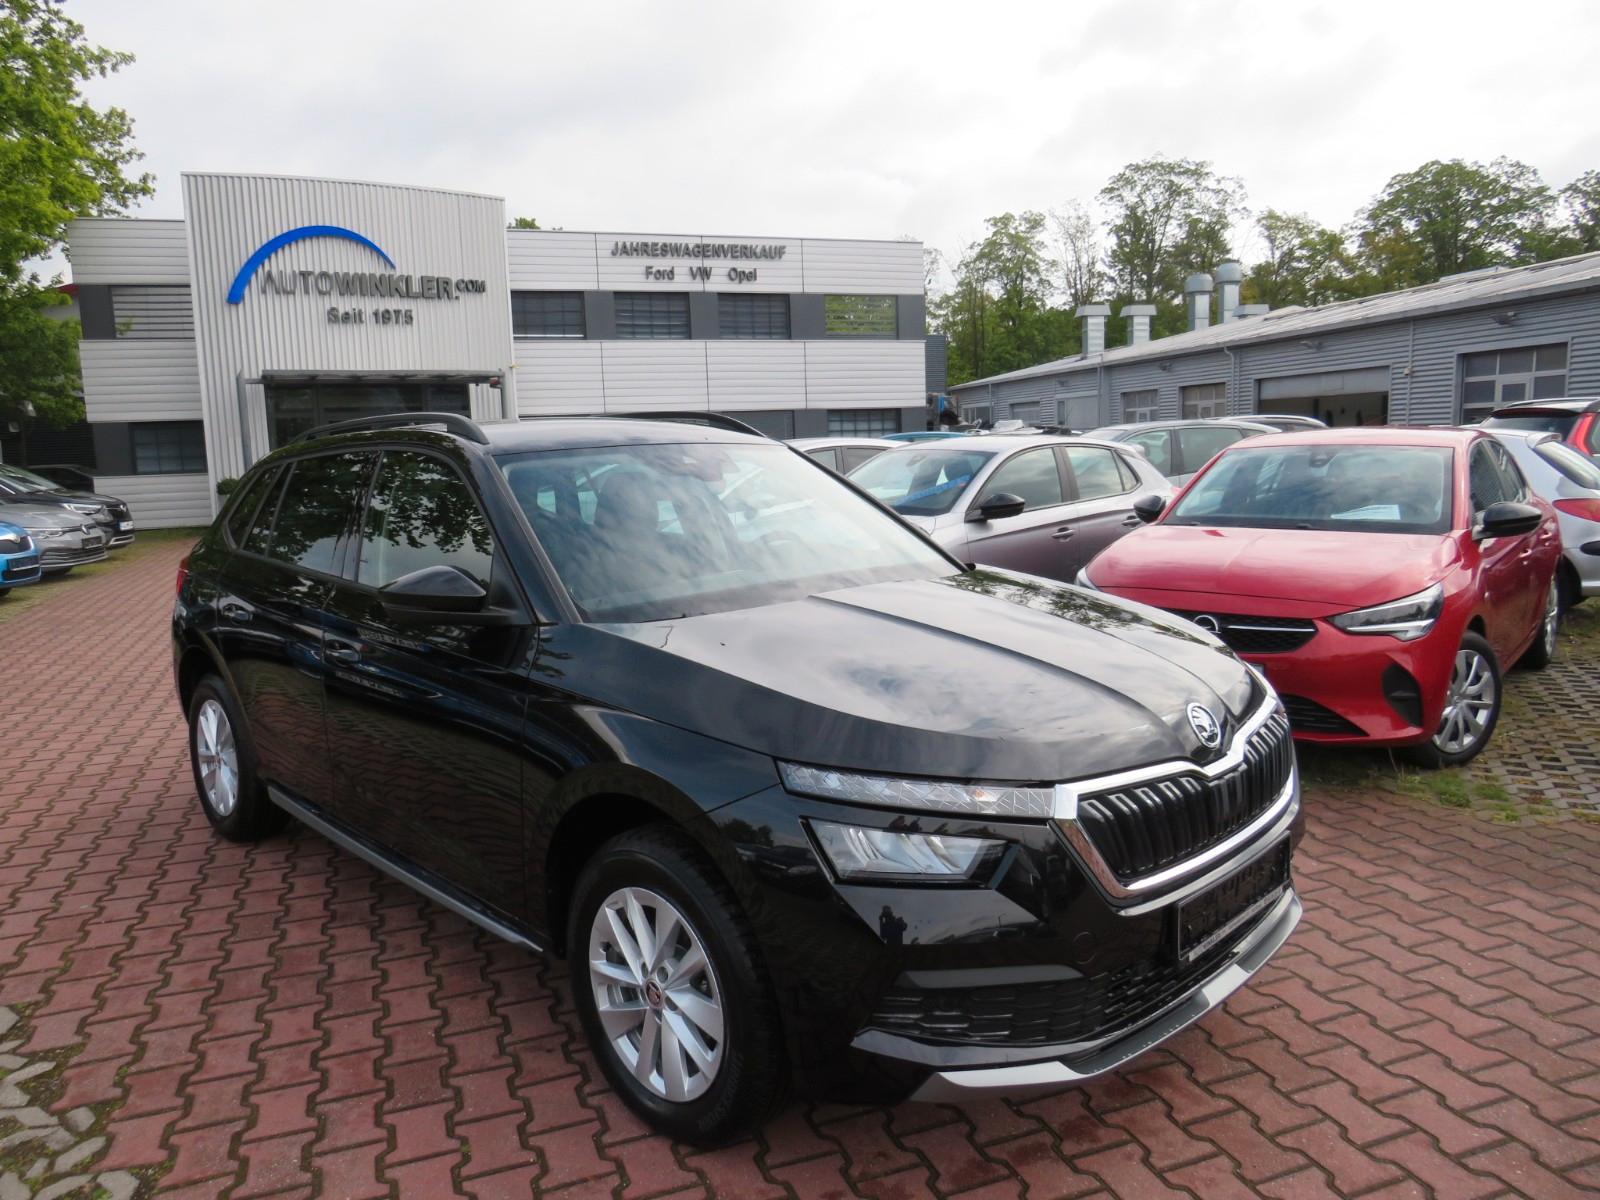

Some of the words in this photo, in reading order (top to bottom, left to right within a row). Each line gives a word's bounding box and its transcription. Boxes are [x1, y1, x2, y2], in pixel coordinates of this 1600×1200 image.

[611, 241, 787, 260] JAHRESWAGENVERKAUF
[645, 265, 675, 281] Ford
[690, 266, 712, 281] VW
[728, 267, 757, 284] Opel
[327, 306, 364, 326] Seit
[372, 308, 414, 326] 1975
